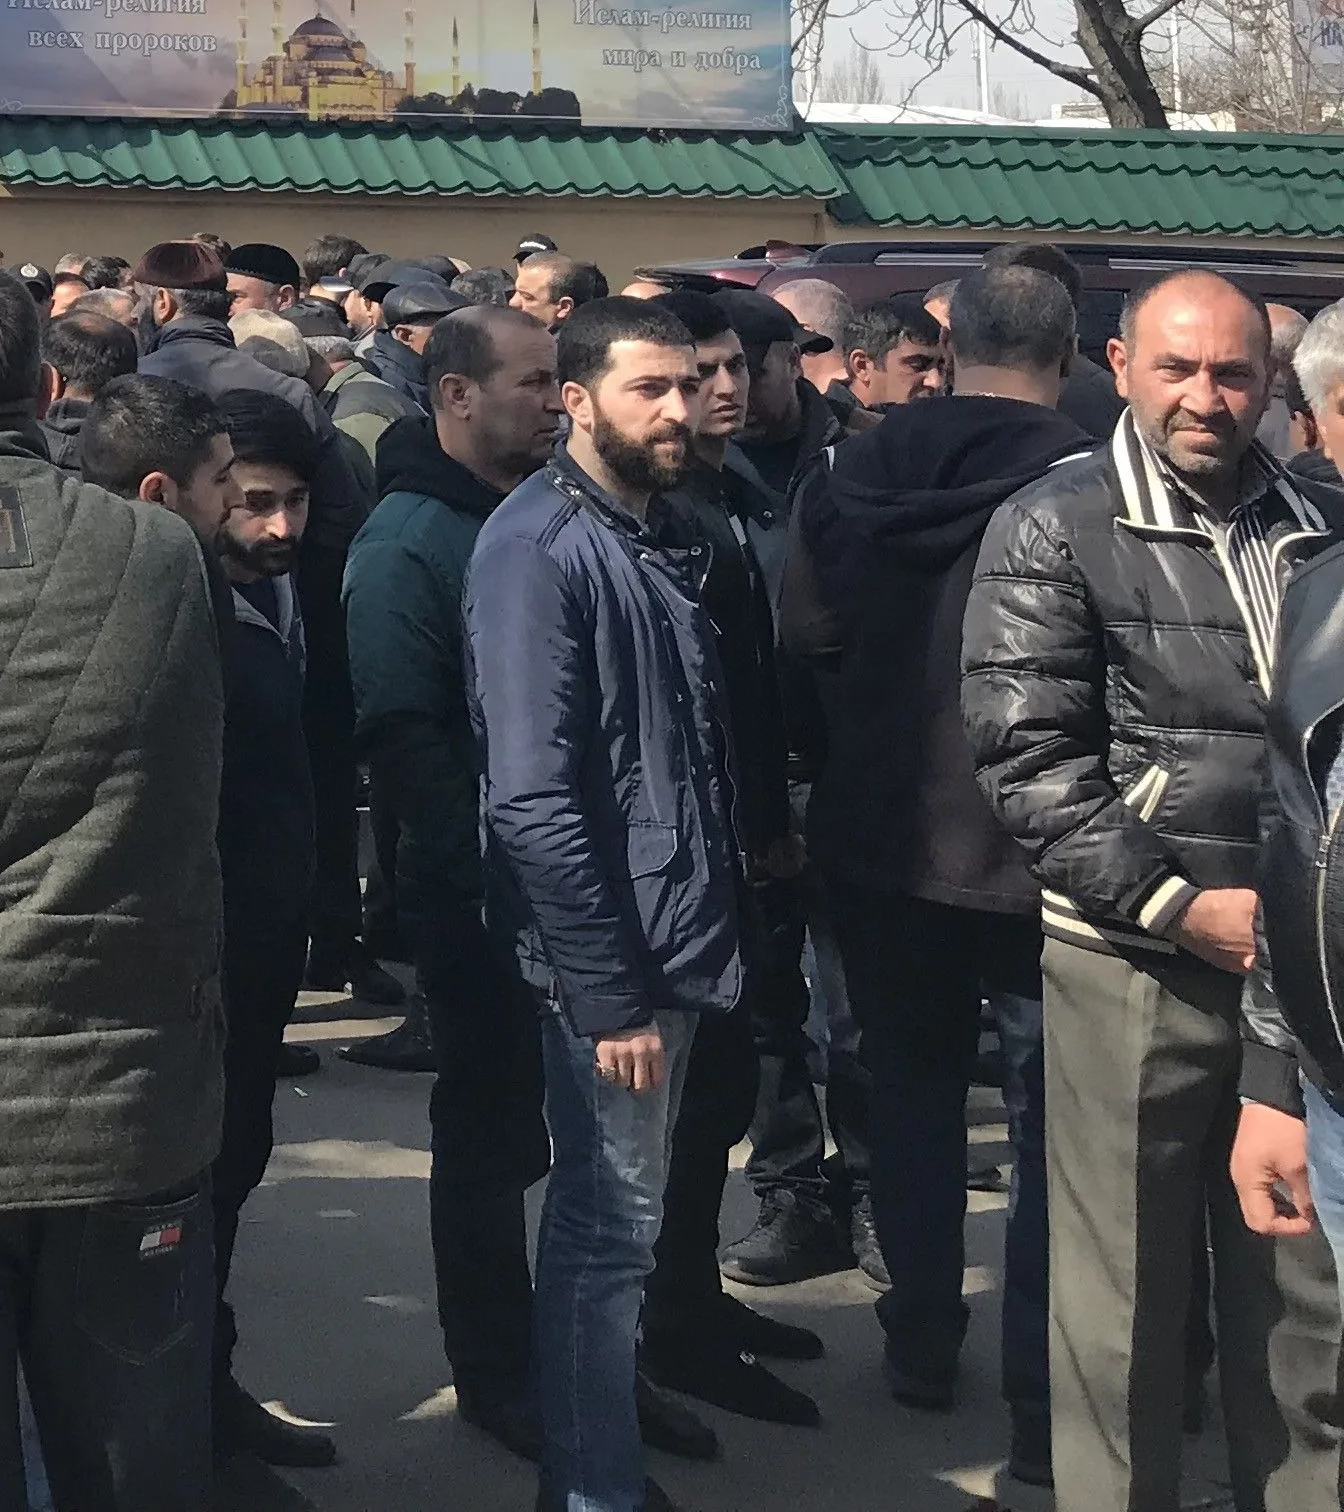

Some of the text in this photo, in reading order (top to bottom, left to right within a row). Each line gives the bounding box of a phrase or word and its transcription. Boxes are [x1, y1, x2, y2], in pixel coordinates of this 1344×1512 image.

[28, 31, 217, 56] всех пророков
[603, 46, 763, 76] мира и добра
